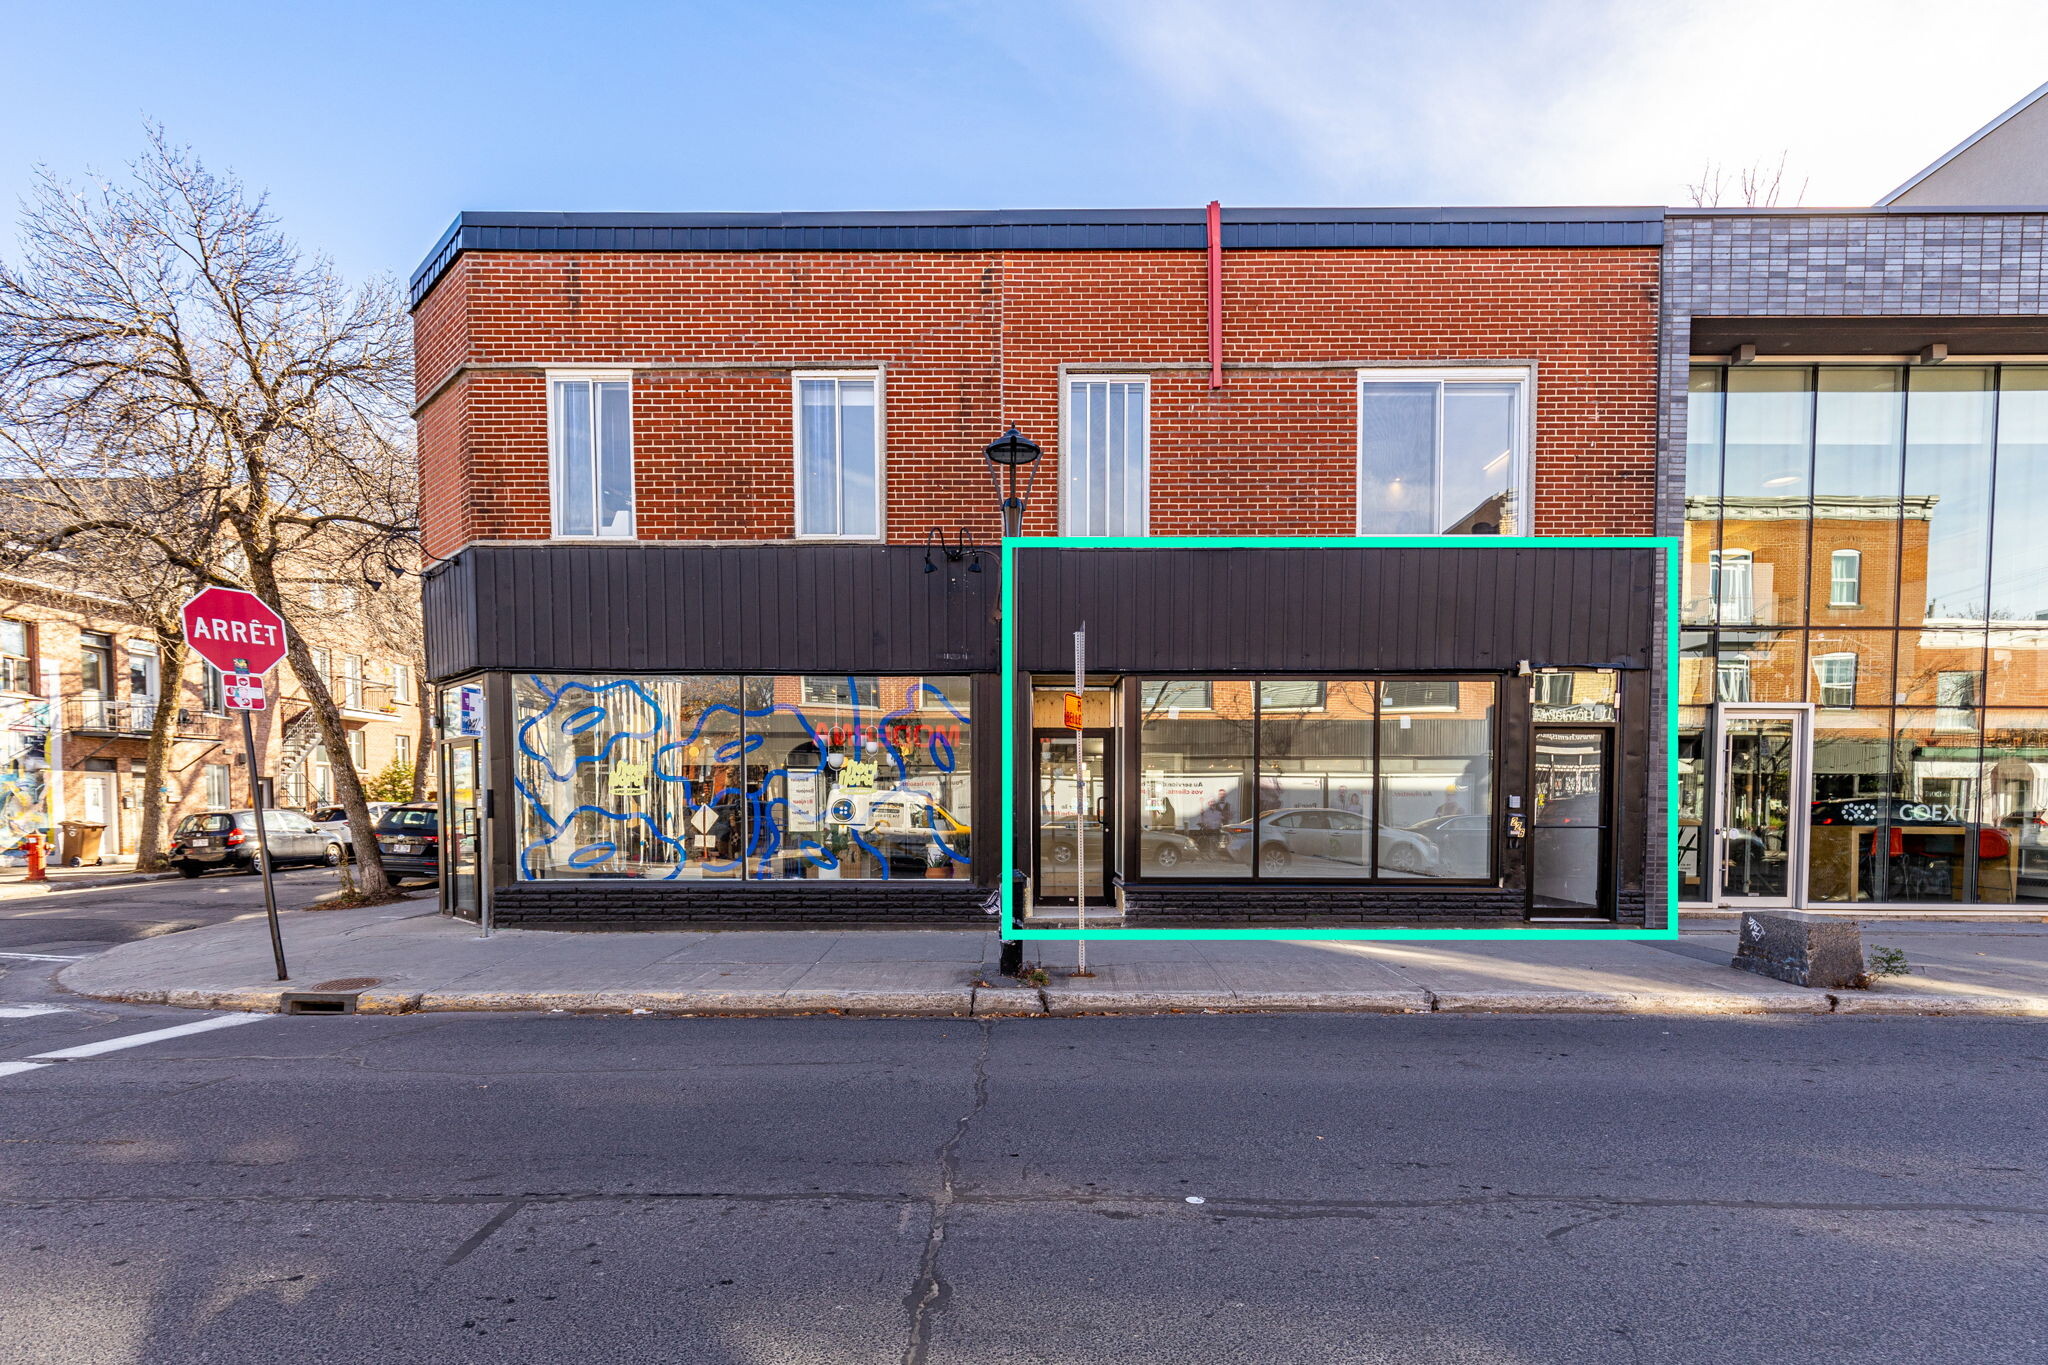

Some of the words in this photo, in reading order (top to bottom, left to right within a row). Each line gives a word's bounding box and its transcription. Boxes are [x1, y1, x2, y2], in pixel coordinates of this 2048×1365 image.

[194, 616, 277, 646] ARRÊT
[1899, 804, 1958, 822] COEX
[1510, 816, 1526, 838] 226
